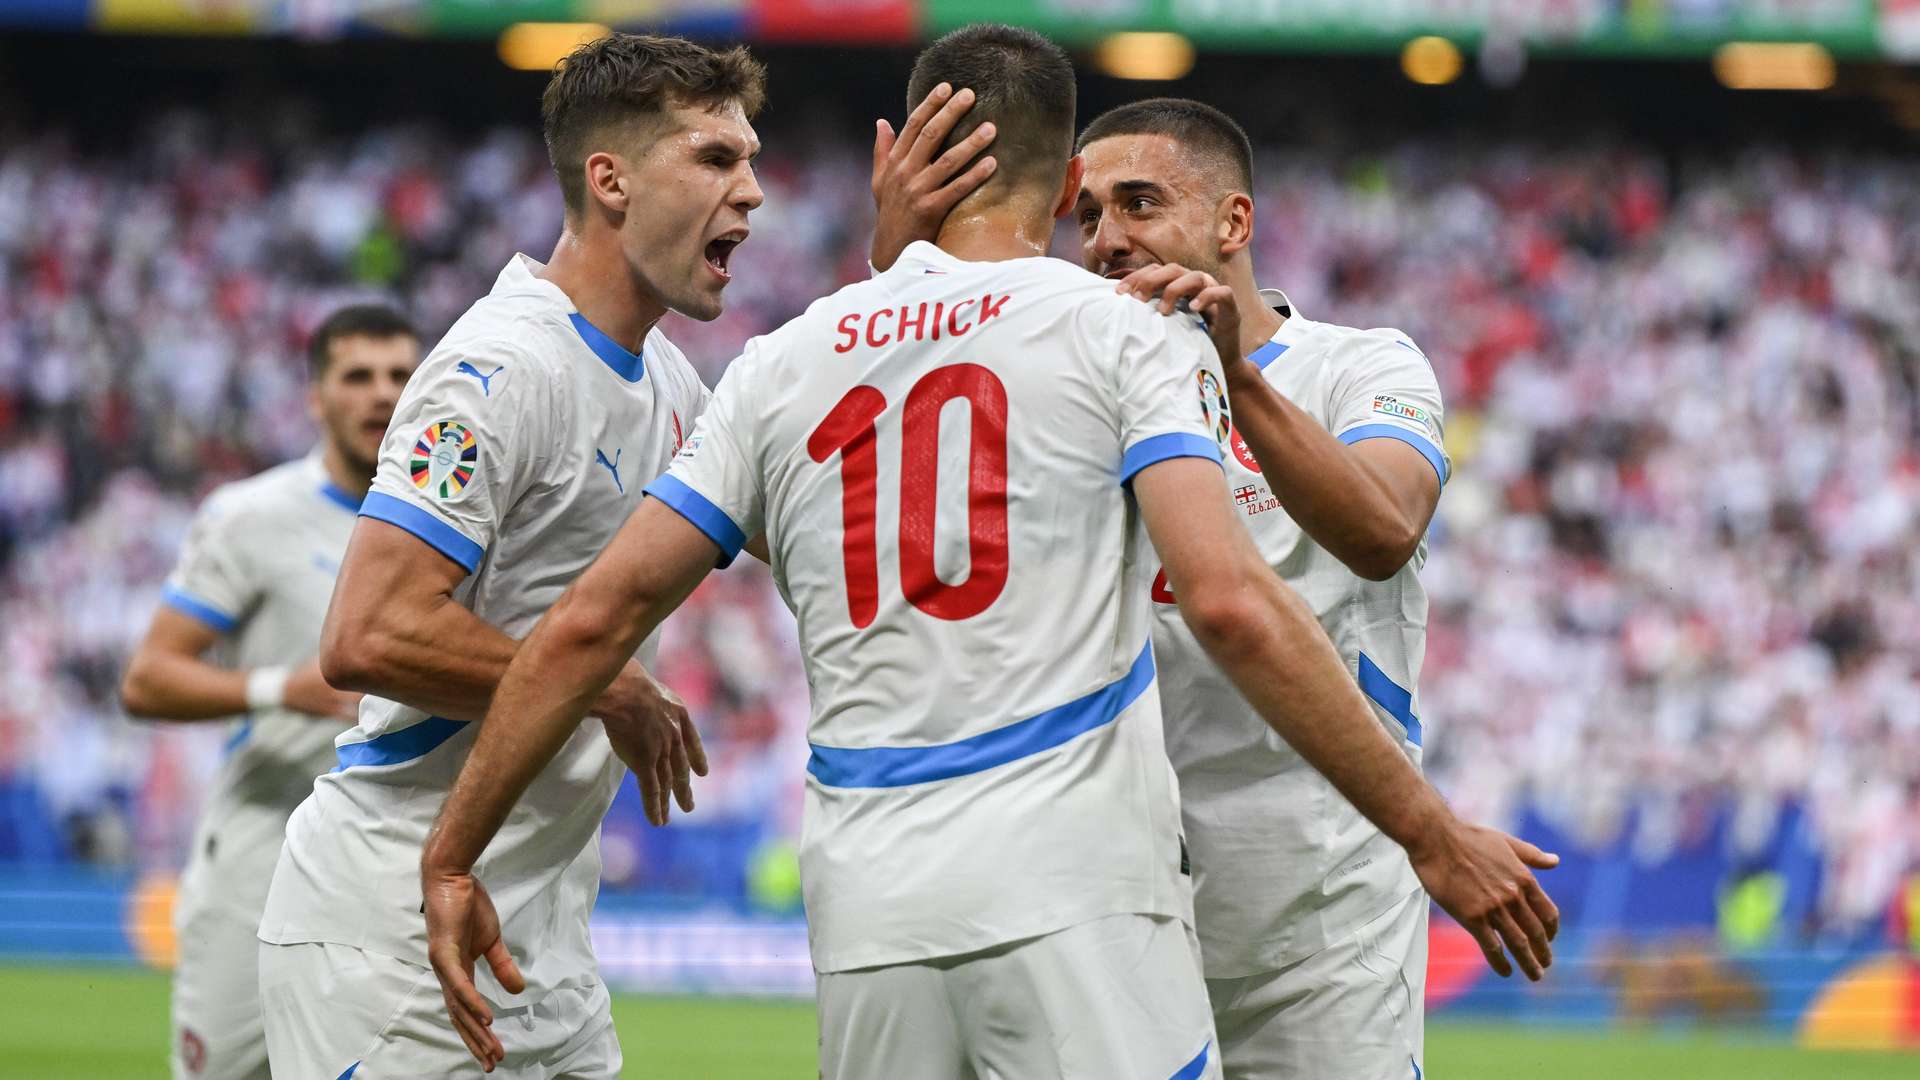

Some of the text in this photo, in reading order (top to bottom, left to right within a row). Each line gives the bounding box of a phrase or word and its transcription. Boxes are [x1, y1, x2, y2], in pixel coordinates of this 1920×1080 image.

[834, 293, 1011, 353] SCHICK
[1374, 394, 1397, 403] UEFA
[806, 362, 1009, 629] 10
